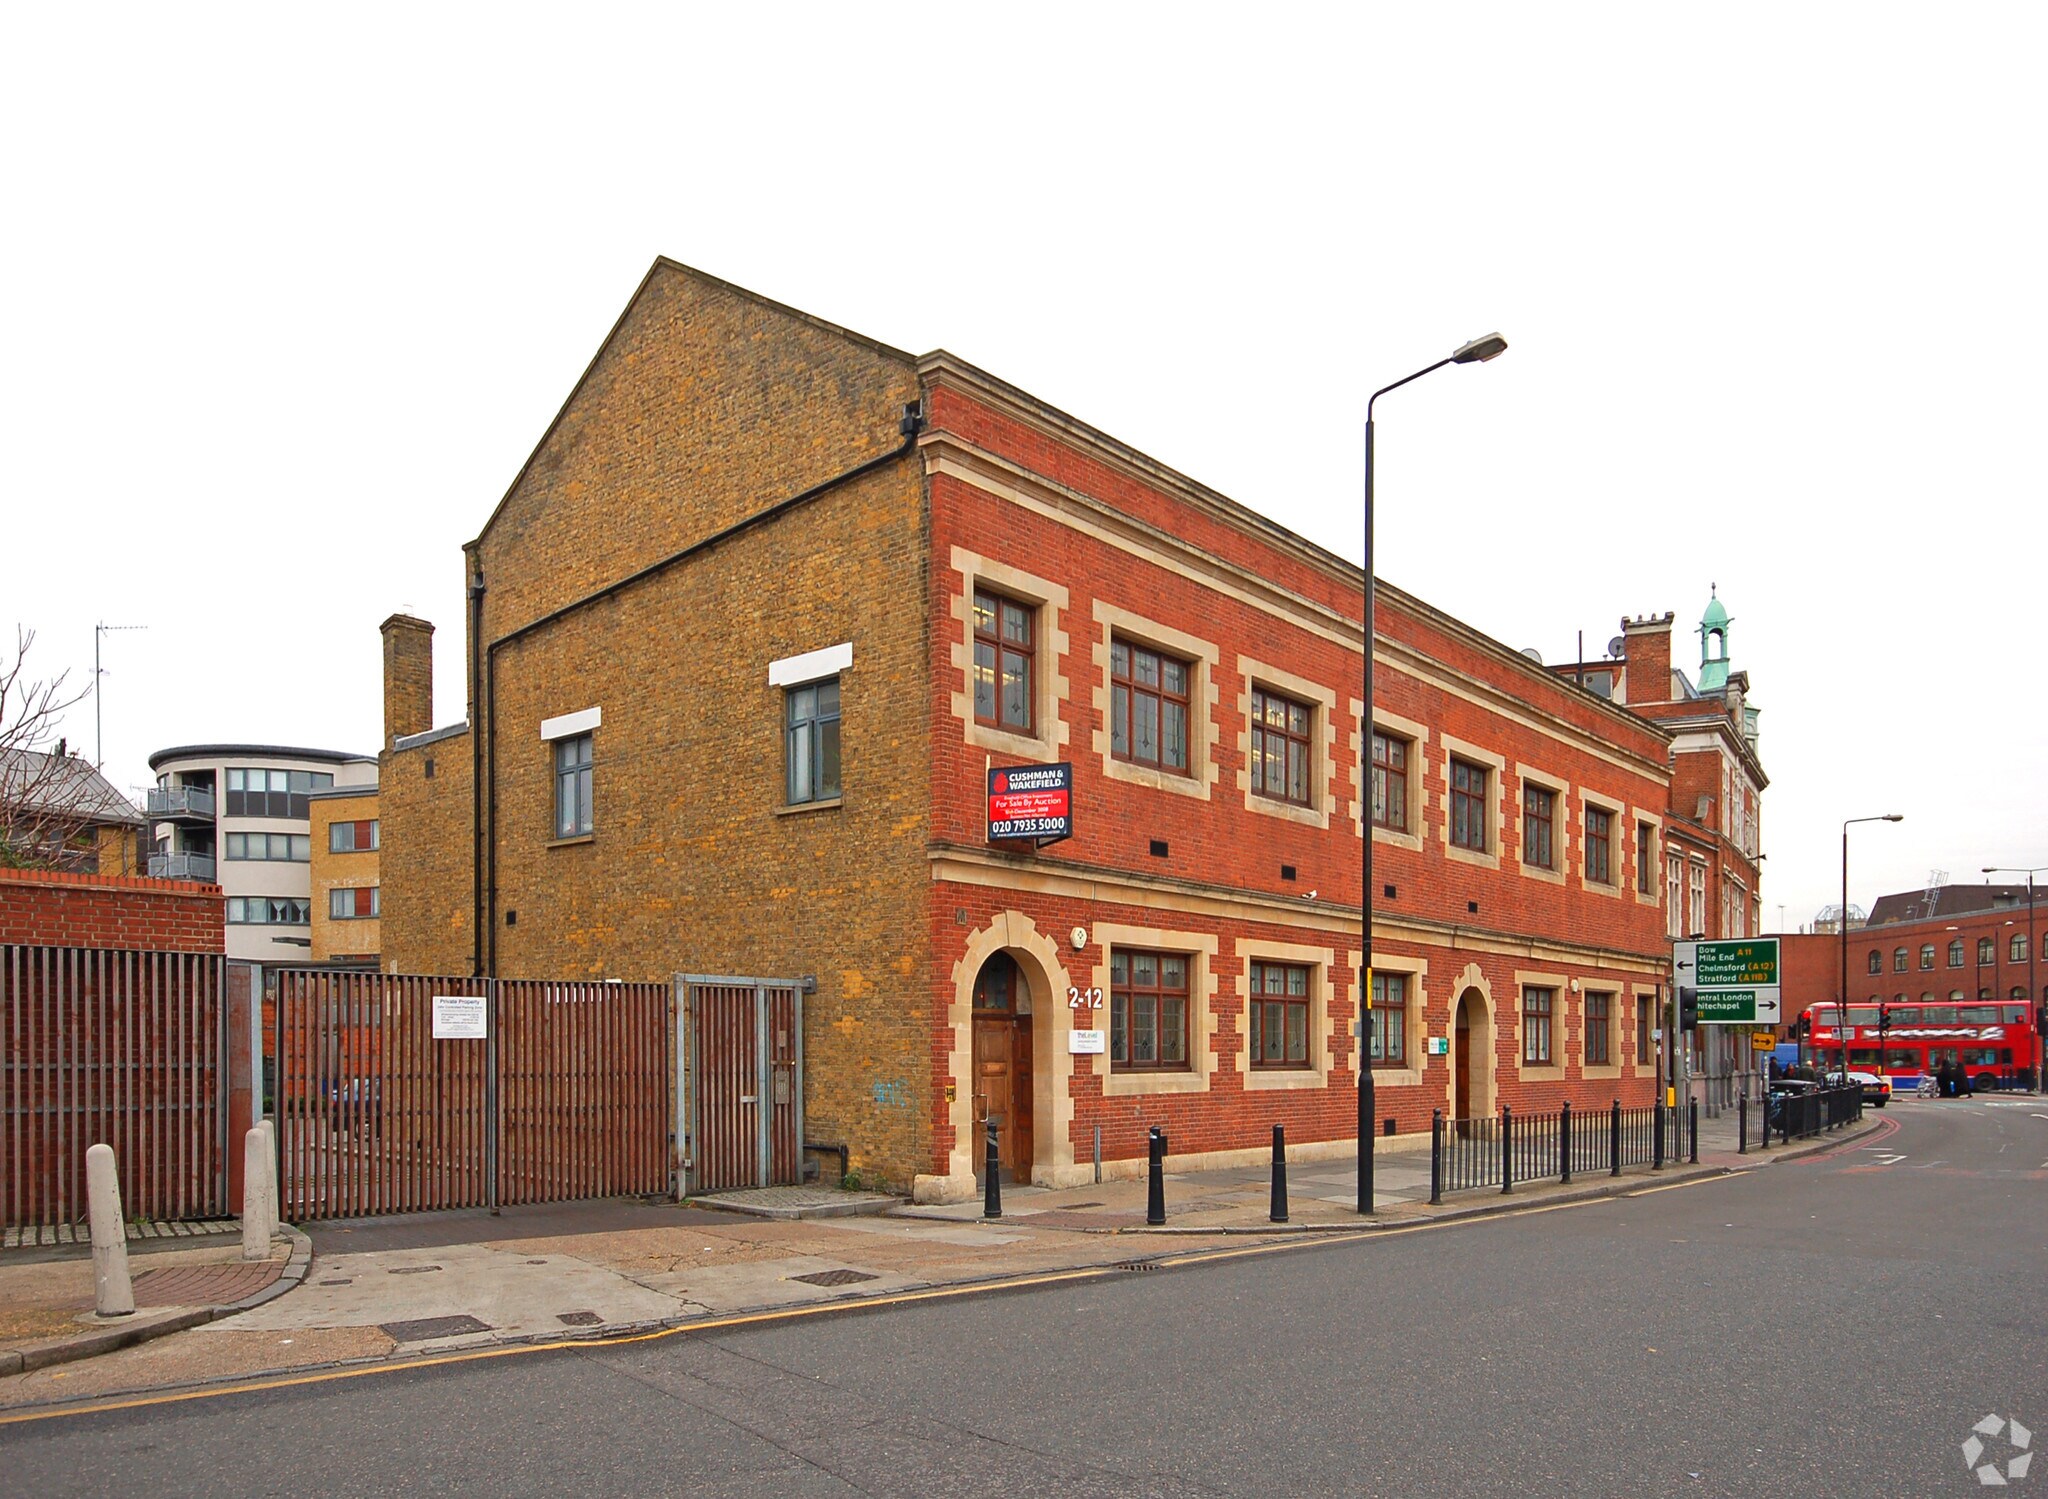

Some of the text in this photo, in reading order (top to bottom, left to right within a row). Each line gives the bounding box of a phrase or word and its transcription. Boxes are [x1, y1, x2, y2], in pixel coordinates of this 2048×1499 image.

[1009, 770, 1064, 782] CUSHMAN &
[1009, 778, 1061, 790] WAKEFIELD
[1009, 800, 1022, 808] Sale
[1023, 799, 1032, 808] By
[1034, 798, 1062, 806] Auction
[992, 817, 1065, 833] 020 7935 5000
[1698, 946, 1717, 954] Bow
[1698, 953, 1735, 962] Mile End
[1698, 963, 1746, 972] Chelmsford
[1698, 974, 1737, 983] Stratford
[1069, 987, 1103, 1009] 2-12
[1722, 993, 1753, 1001] London
[1697, 1002, 1740, 1011] hitechapel
